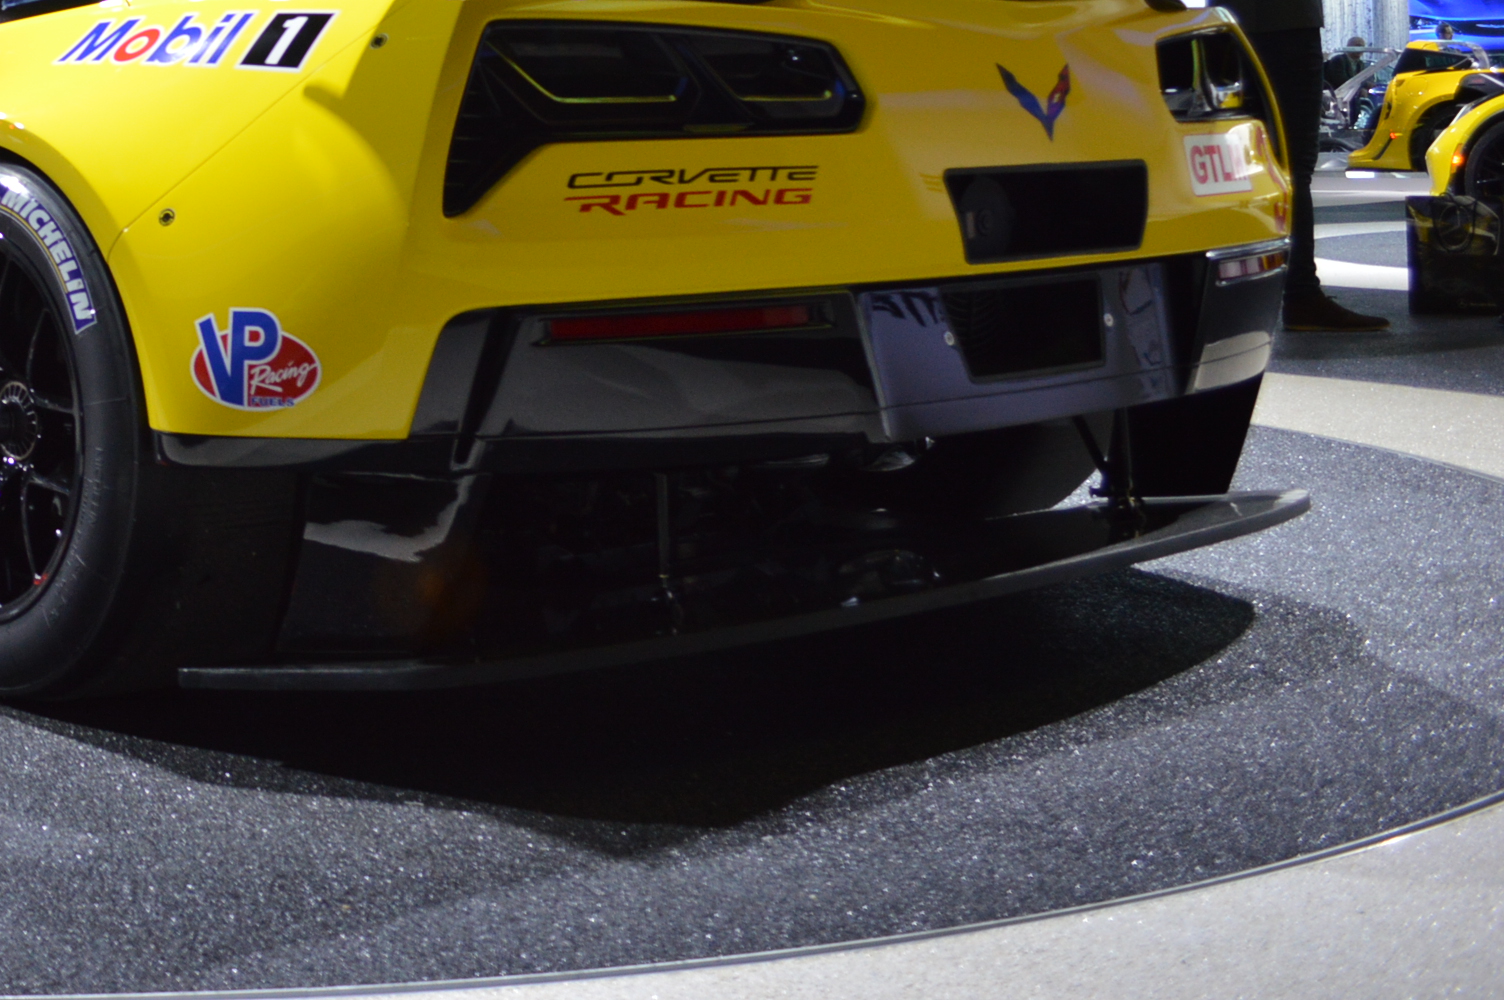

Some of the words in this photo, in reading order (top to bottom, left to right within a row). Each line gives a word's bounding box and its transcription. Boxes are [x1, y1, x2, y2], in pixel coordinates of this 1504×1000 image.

[57, 12, 254, 65] Mobil
[567, 165, 820, 190] CORVETTE
[564, 188, 813, 216] RACING
[0, 187, 94, 321] MICHELIN
[196, 308, 281, 408] VP
[250, 360, 318, 396] Racing
[251, 397, 295, 407] FUELS
